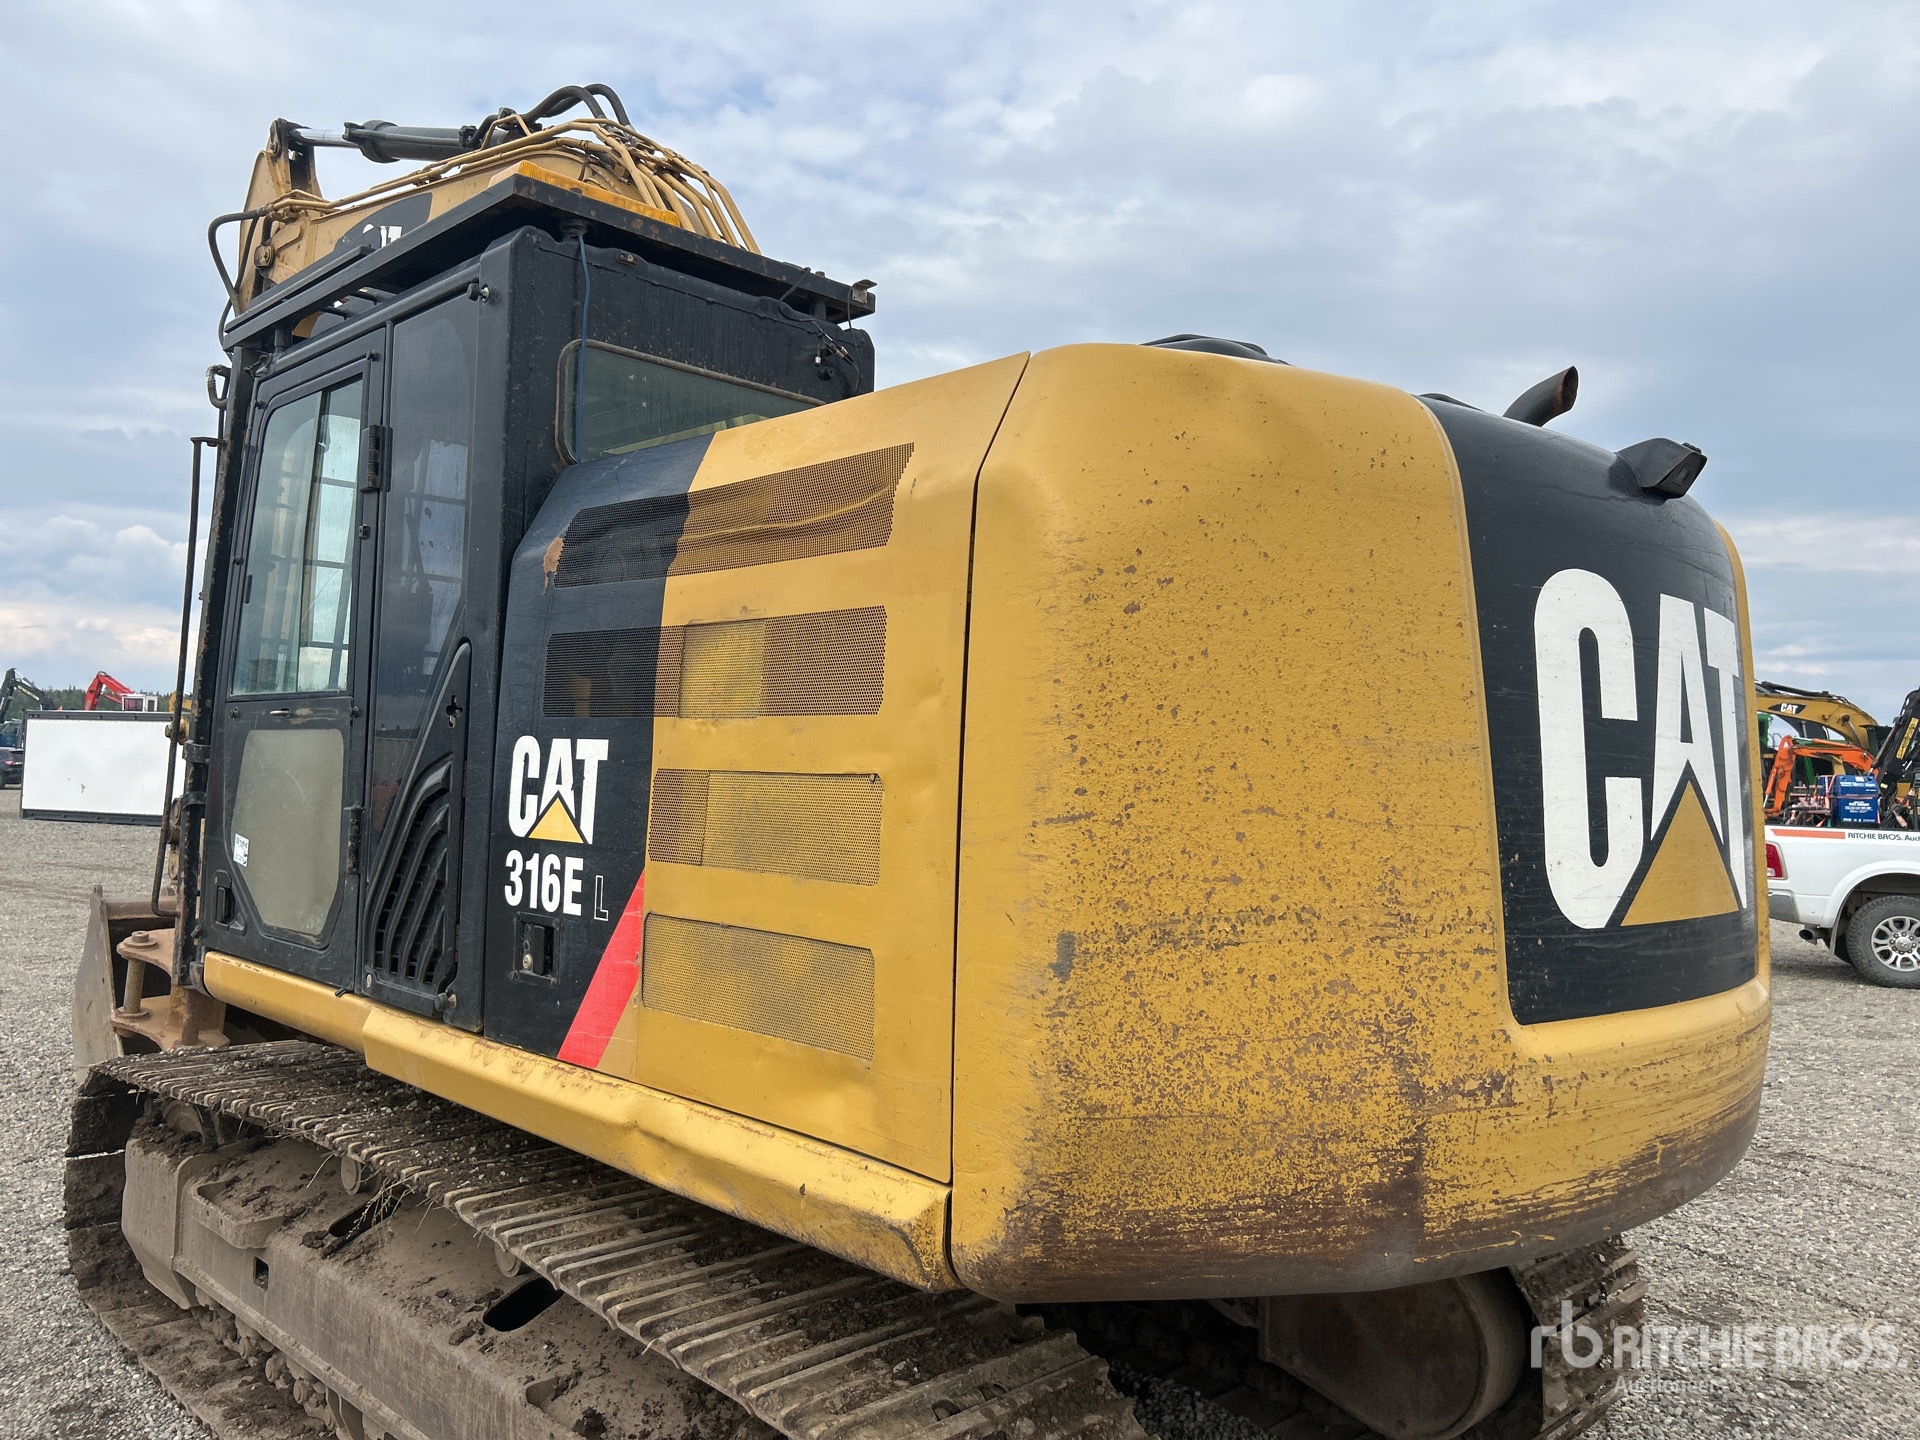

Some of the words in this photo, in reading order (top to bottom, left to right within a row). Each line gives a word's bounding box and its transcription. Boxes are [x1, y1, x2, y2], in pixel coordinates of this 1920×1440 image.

[1780, 703, 1799, 715] CAT
[1533, 568, 1747, 930] CAT
[508, 735, 610, 845] CAT
[1848, 832, 1876, 840] RITCHIE
[1878, 833, 1903, 841] BROS.
[504, 849, 584, 917] 316E
[593, 875, 609, 922] L
